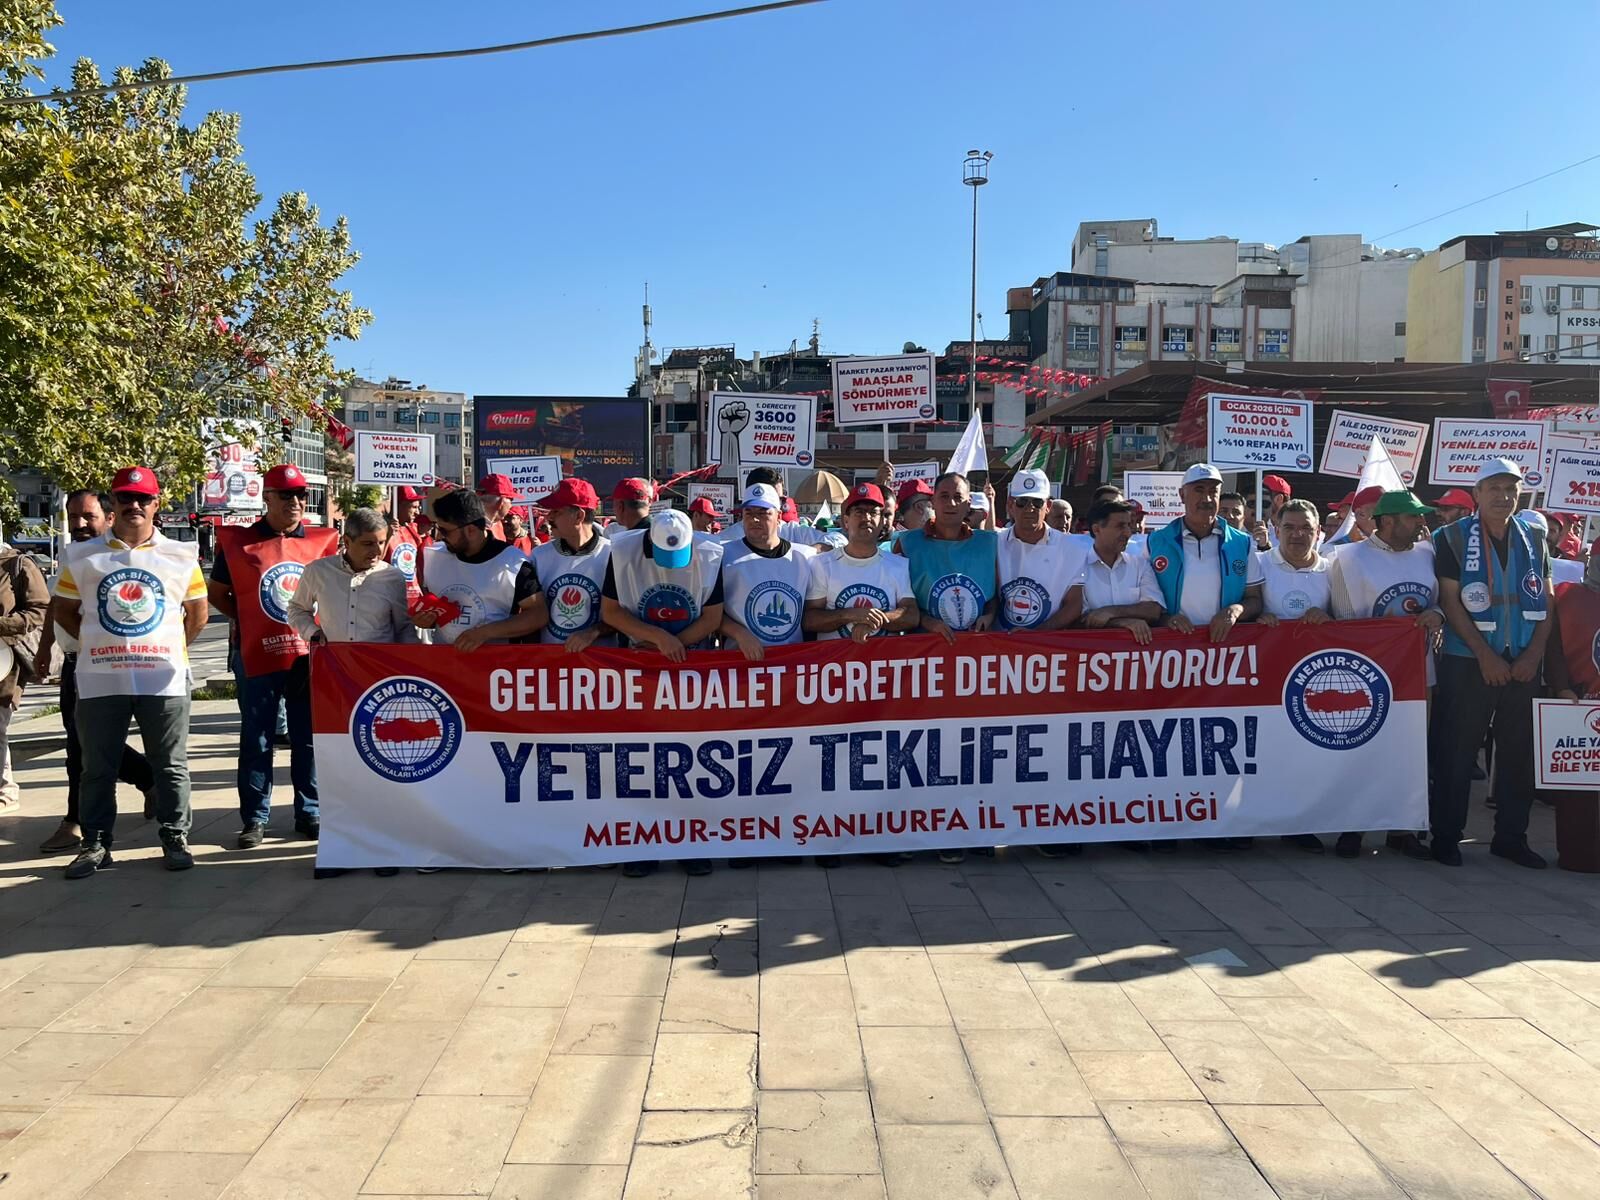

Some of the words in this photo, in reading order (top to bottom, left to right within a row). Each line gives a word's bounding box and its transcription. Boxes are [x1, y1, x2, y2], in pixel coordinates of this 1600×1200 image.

[1503, 280, 1514, 350] BENİM
[1567, 317, 1600, 327] KPSS-
[852, 374, 913, 386] MAAŞLAR
[842, 386, 927, 400] SÖNDÜRMEYE
[852, 400, 918, 412] YETMİYOR!
[1226, 402, 1252, 411] OCAK
[1252, 404, 1273, 412] 2026
[1274, 405, 1294, 414] İÇİN:
[755, 410, 796, 423] 3600
[1231, 414, 1278, 426] 10.000
[1225, 426, 1258, 435] TABAN
[1260, 428, 1293, 438] AYLIĞA
[1339, 419, 1360, 429] AİLE
[1360, 422, 1391, 434] DOSTU
[1392, 428, 1419, 438] VERGİ
[1453, 429, 1526, 437] ENFLASYONA
[754, 432, 795, 442] HEMEN
[1346, 431, 1406, 446] POLİTİALARI
[372, 443, 418, 452] YÜKSELTİN
[753, 442, 795, 456] ŞİMDİ!
[1217, 438, 1244, 447] +%10
[1246, 440, 1279, 450] REFAH
[1281, 442, 1303, 451] PAYI
[1441, 441, 1497, 450] YENİLEN
[1500, 440, 1538, 450] DEĞİL
[1244, 452, 1276, 462] +%25
[1560, 456, 1580, 465] AĞIR
[1581, 459, 1600, 467] GELİ
[373, 461, 417, 469] PİYASAYI
[511, 465, 539, 474] İLAVE
[373, 471, 417, 479] DÜZELTİN!
[965, 579, 981, 598] SEN
[1377, 588, 1398, 607] TOÇ
[1294, 656, 1379, 686] MEMUR-SEN
[489, 668, 643, 712] GELİRDE
[654, 665, 786, 711] ADALET
[796, 656, 944, 705] ÜCRETTE
[955, 653, 1066, 697] DENGE
[1076, 645, 1259, 692] İSTİYORUZ!
[363, 683, 450, 714] MEMUR-SEN
[1292, 695, 1303, 722] MEMUR
[1555, 736, 1587, 748] AİLE
[360, 723, 370, 753] MEMUR
[366, 752, 411, 778] SENDİKALARI
[412, 722, 456, 777] KONFEDERASYONU
[489, 737, 793, 803] YETERSİZ
[809, 724, 1049, 792] TEKLİFE
[1067, 715, 1258, 780] HAYIR!
[1550, 760, 1580, 773] BİLE
[1583, 761, 1600, 772] YE
[582, 815, 781, 847] MEMUR-SEN
[792, 807, 969, 845] ŞANLIURFA
[978, 800, 1005, 829] İL
[1012, 791, 1218, 827] TEMSİLCİLİĞİ
